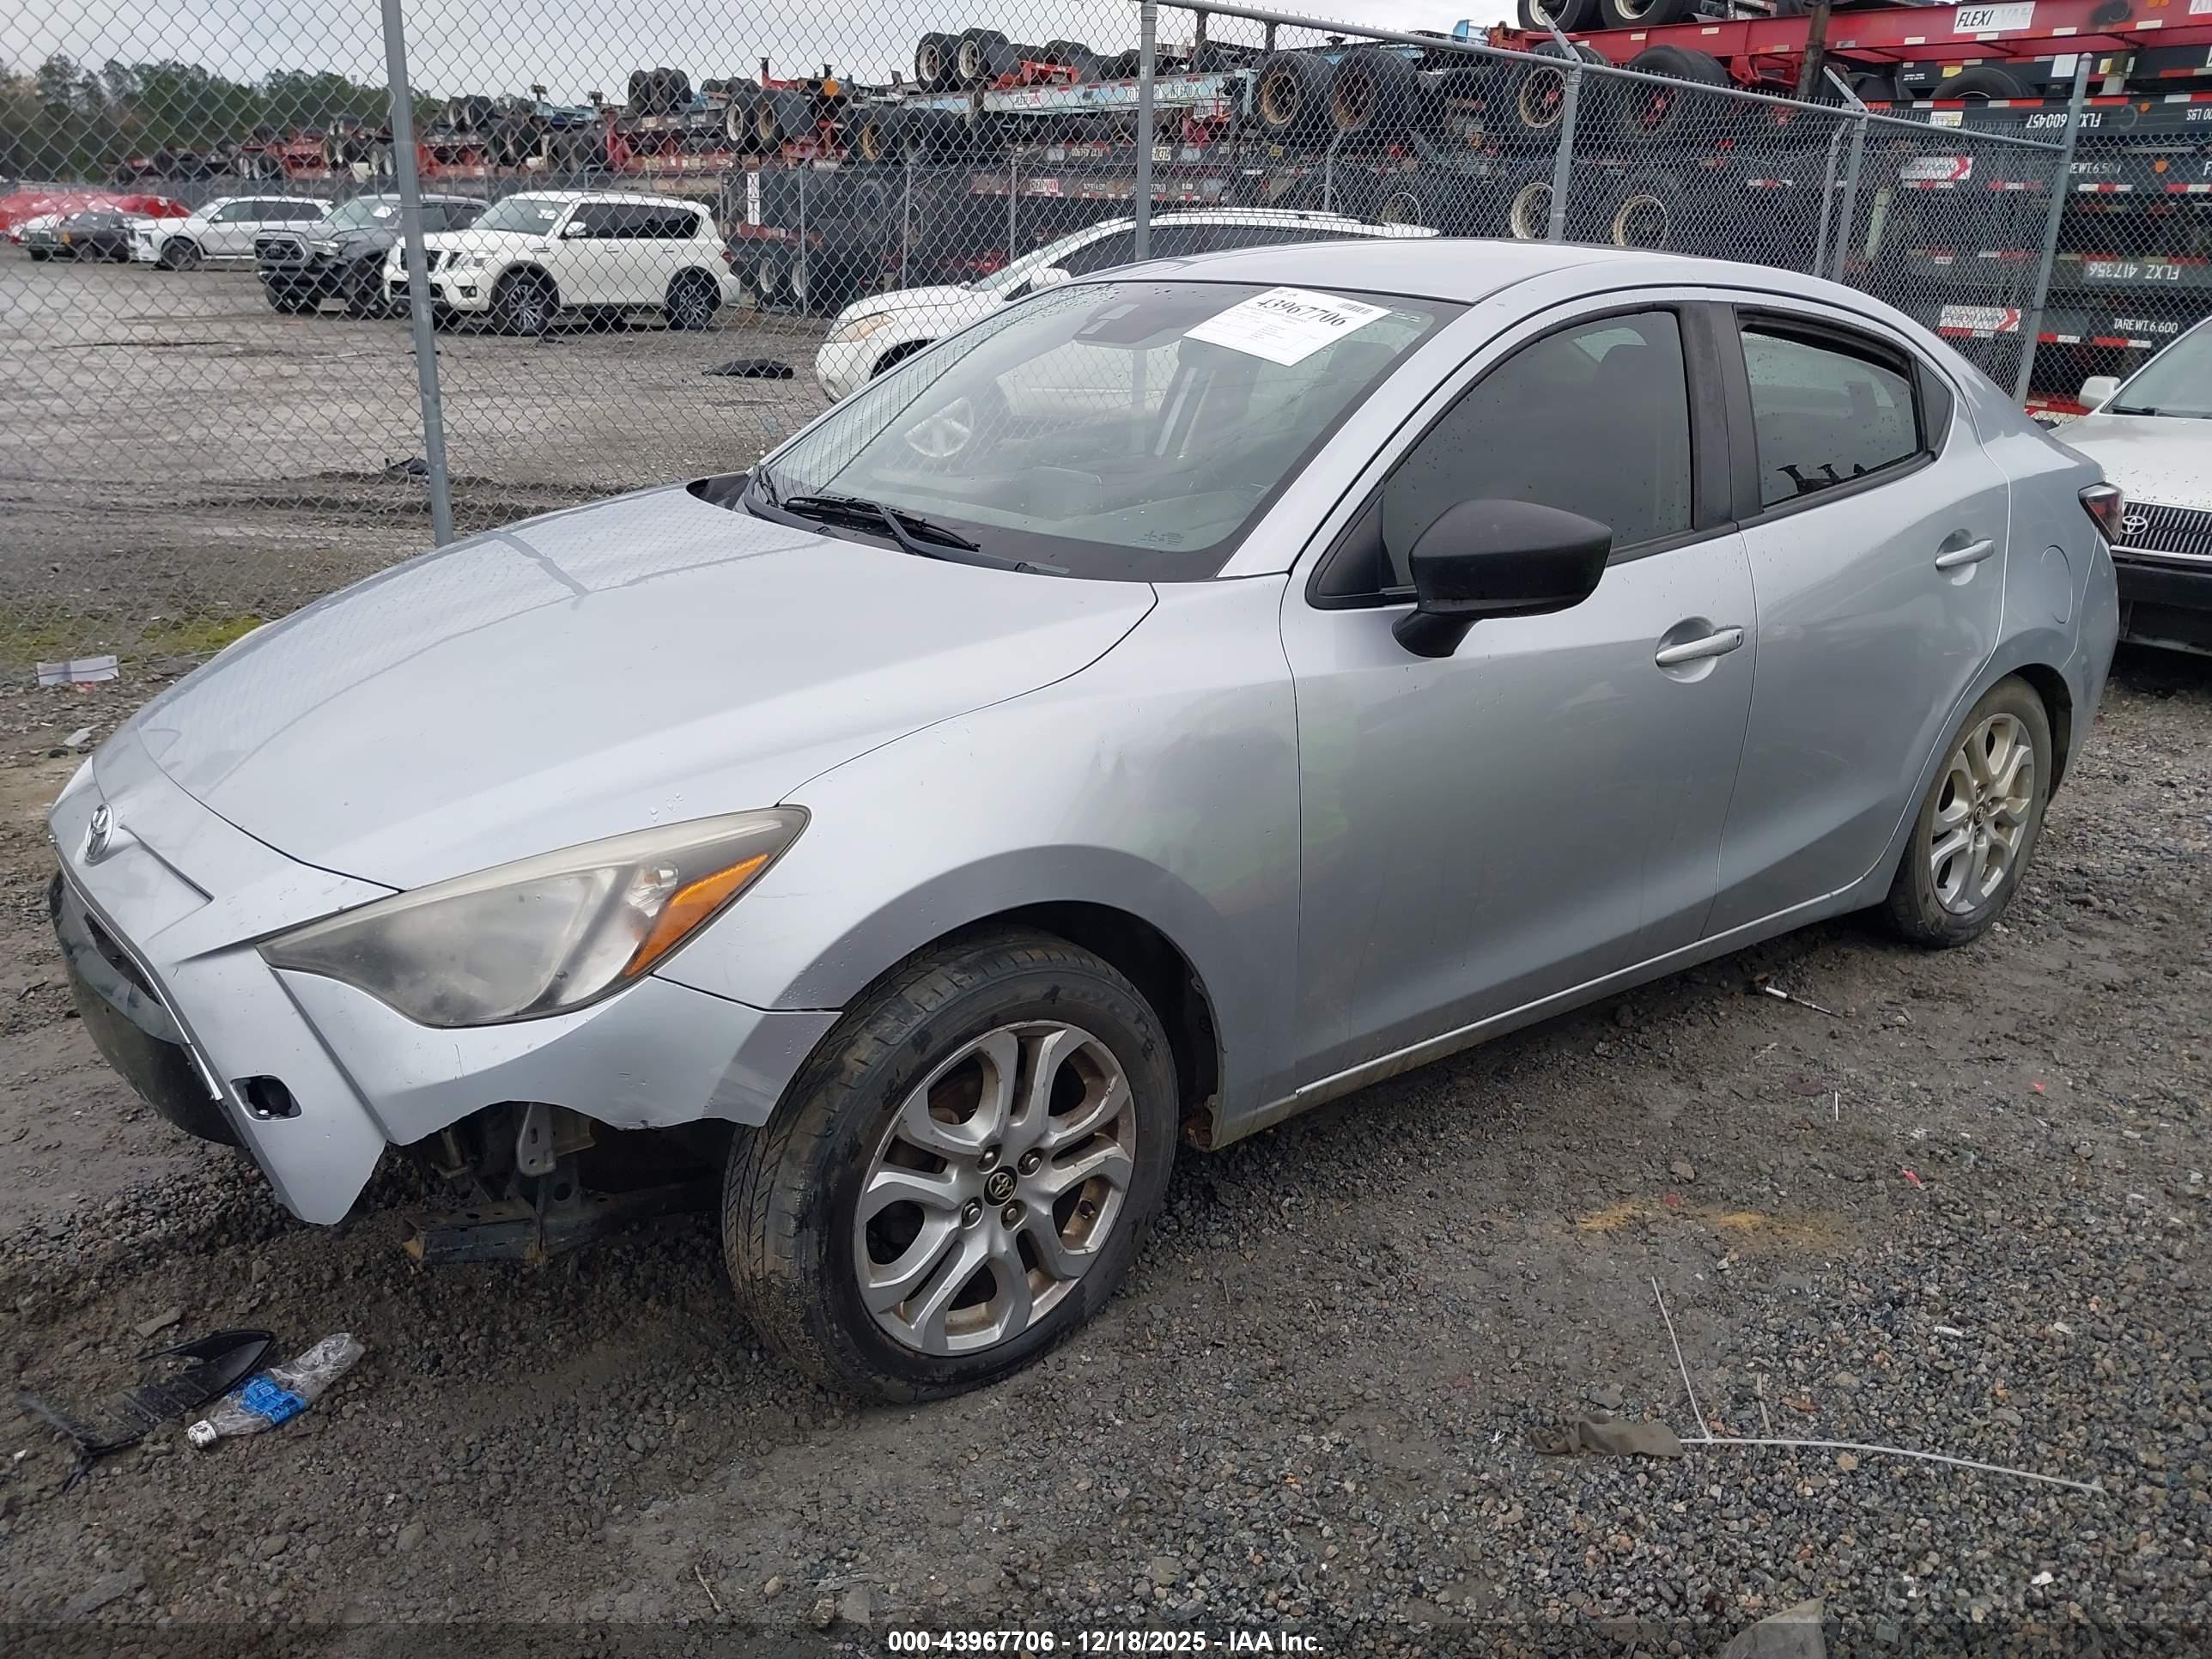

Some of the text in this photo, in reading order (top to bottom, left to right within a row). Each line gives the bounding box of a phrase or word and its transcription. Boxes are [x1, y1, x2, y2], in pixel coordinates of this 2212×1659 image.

[2026, 112, 2102, 129] FLX 600457
[2089, 263, 2179, 280] FLXZ 417356
[1256, 296, 1354, 327] 43967706
